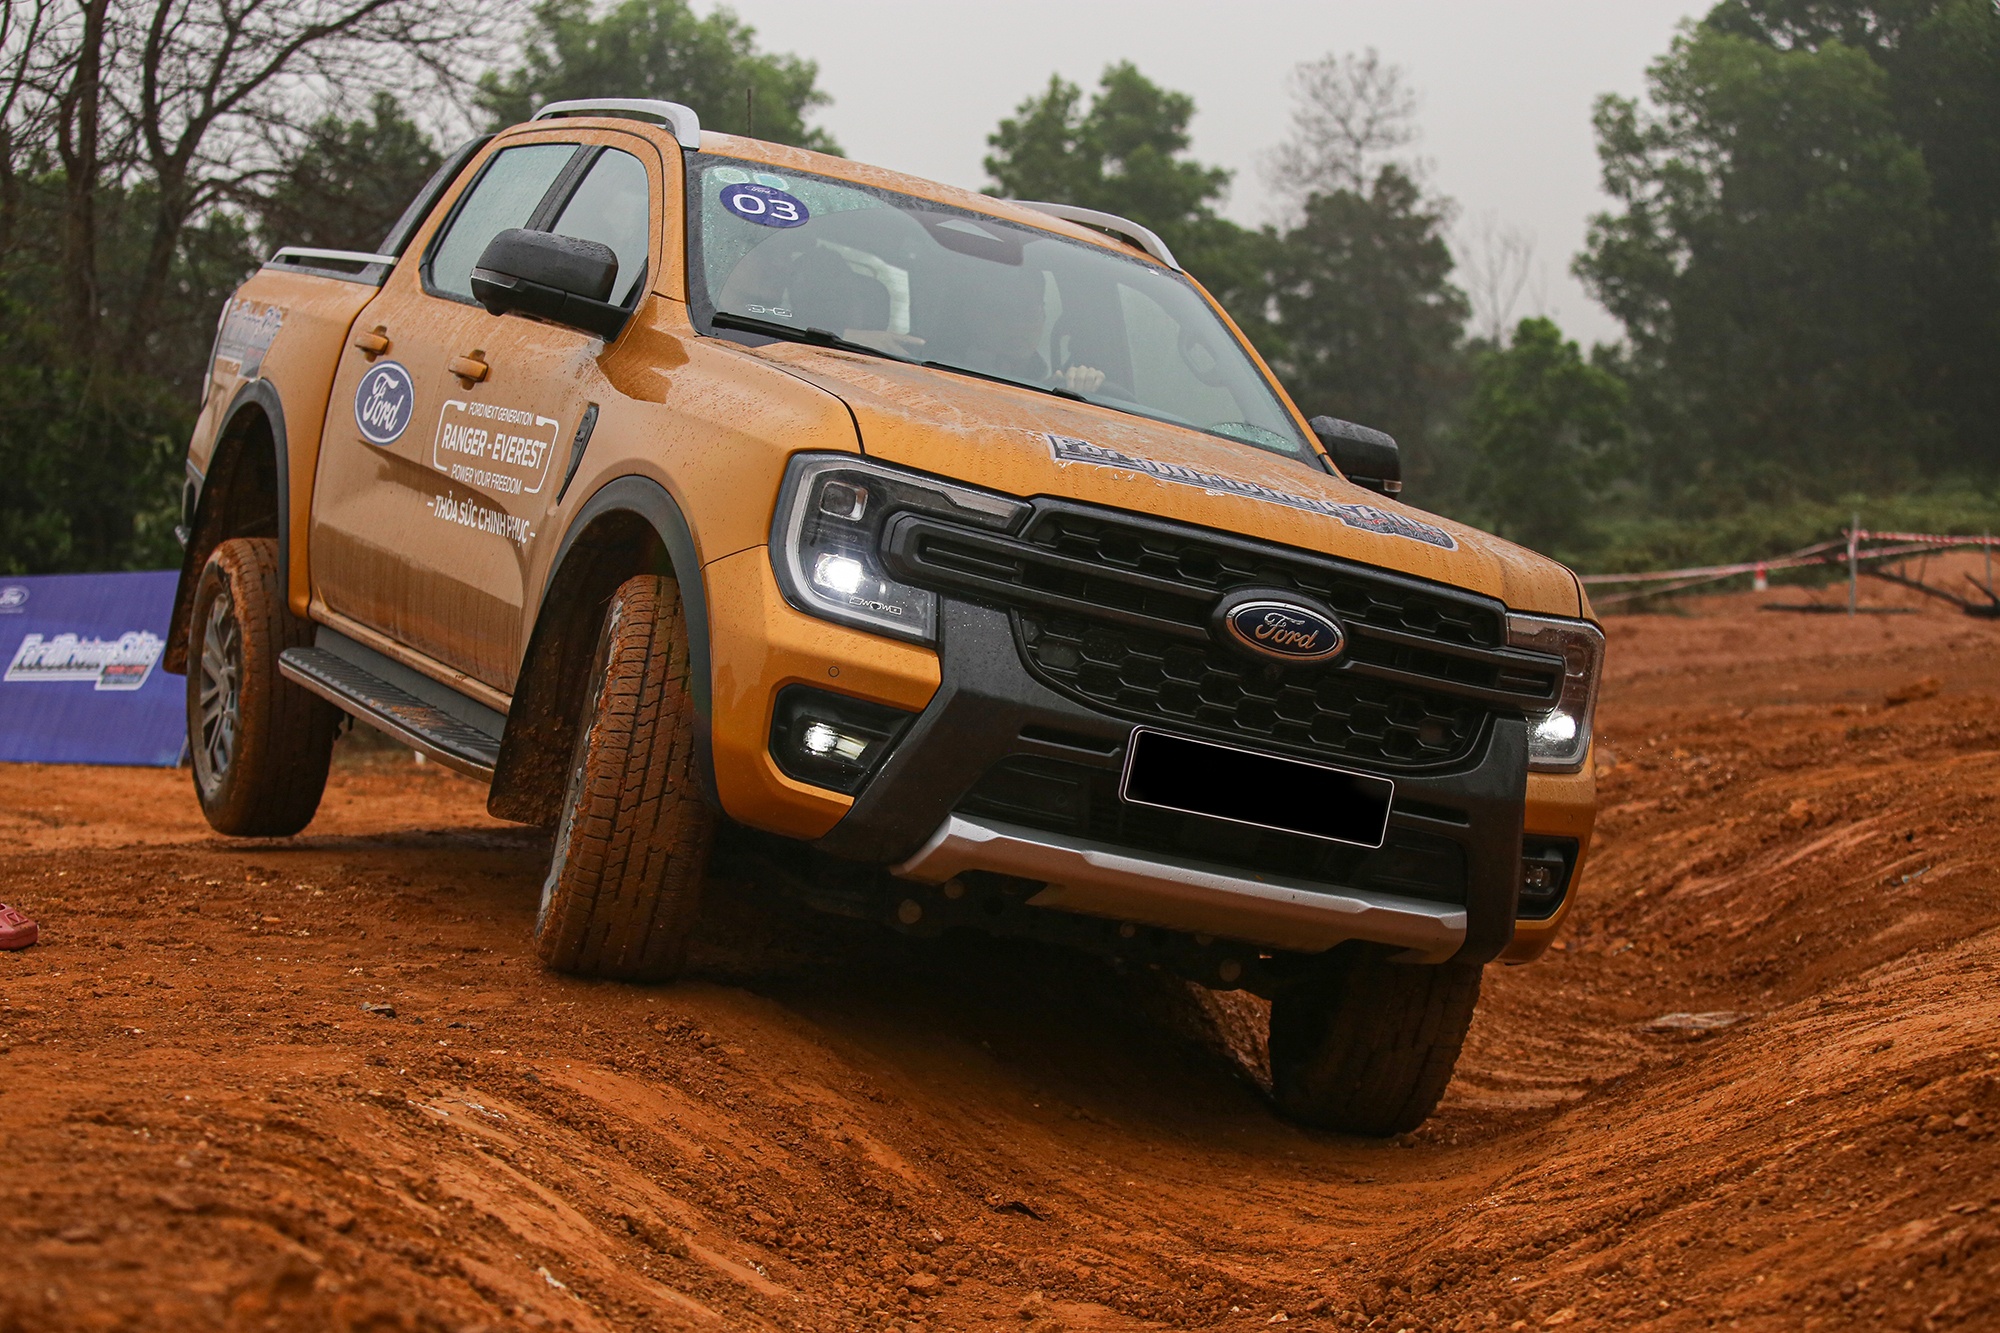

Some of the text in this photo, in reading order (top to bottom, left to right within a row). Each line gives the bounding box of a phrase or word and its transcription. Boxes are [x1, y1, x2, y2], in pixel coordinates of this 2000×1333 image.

[733, 194, 799, 221] 03
[362, 372, 405, 432] Ford
[468, 402, 535, 426] FORD NEXT GENERATION
[441, 423, 488, 457] RANGER
[491, 433, 548, 469] EVEREST
[451, 464, 523, 495] POWER YOUR FREEDOM
[434, 490, 458, 523] THỎA
[458, 498, 479, 528] SỨC
[478, 507, 507, 537] CHINH
[1255, 612, 1320, 650] Ford
